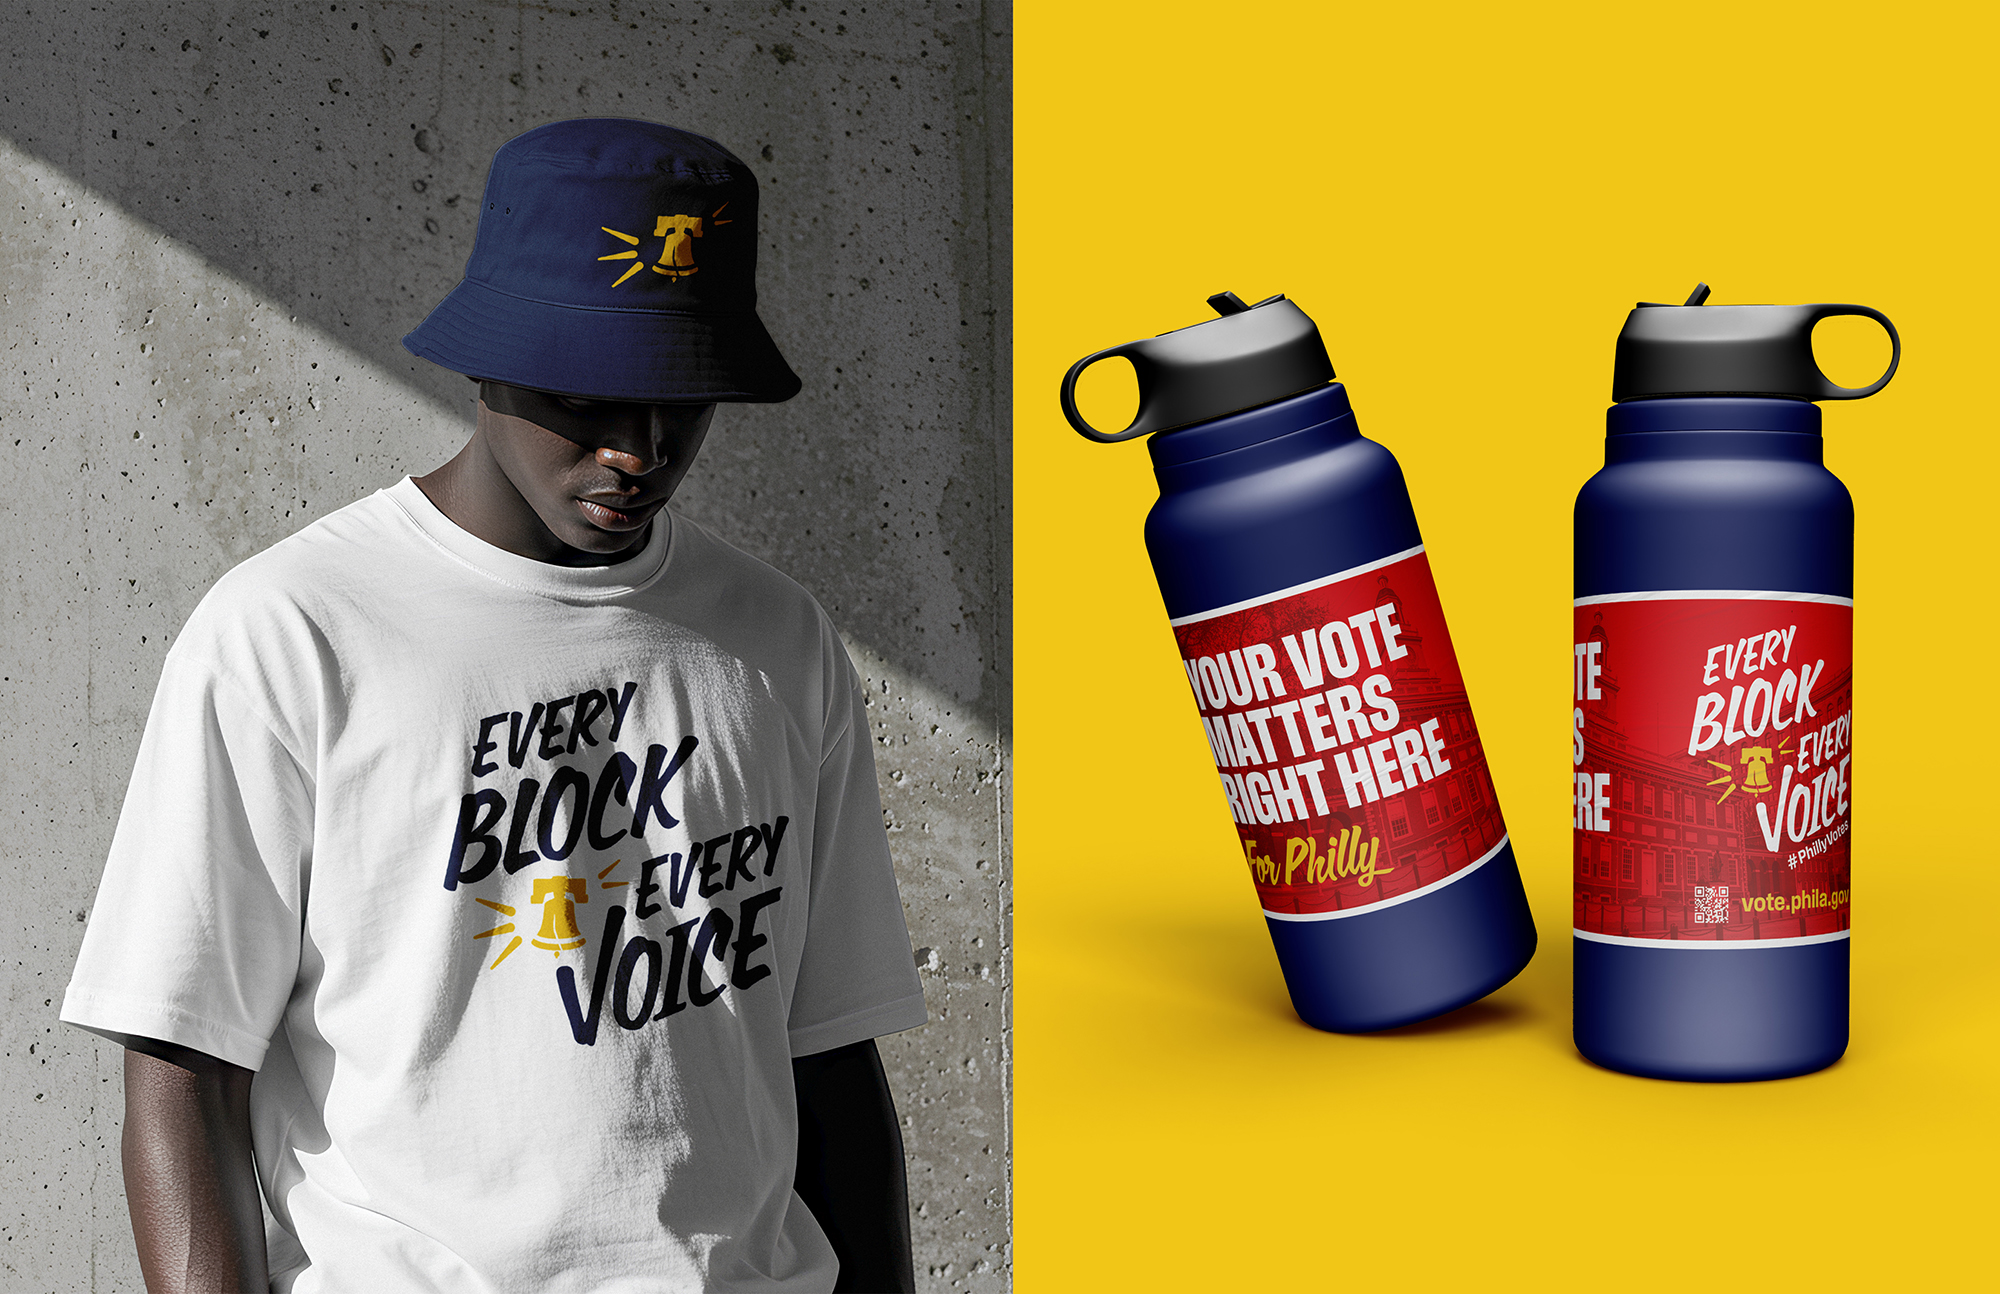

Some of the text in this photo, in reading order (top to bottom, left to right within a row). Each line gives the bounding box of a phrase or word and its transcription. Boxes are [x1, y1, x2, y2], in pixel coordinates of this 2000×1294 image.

[1183, 602, 1408, 711] YOUR VOTE
[1573, 641, 1602, 701] TE
[1702, 625, 1797, 686] EVERY
[471, 682, 637, 778] EVERY
[1201, 673, 1400, 768] MATTERS
[1688, 659, 1824, 756] BLOCK
[1797, 709, 1851, 774] EVERY
[443, 735, 699, 891] BLOCK
[1219, 717, 1452, 825] RIGHT HERE
[1756, 753, 1851, 853] VOICE
[635, 815, 789, 920] EVERY
[1244, 825, 1395, 887] For Philly
[1787, 820, 1849, 870] #PhillyVotes
[1741, 888, 1850, 914] vote.phila.gov
[556, 886, 783, 1046] VOICE
